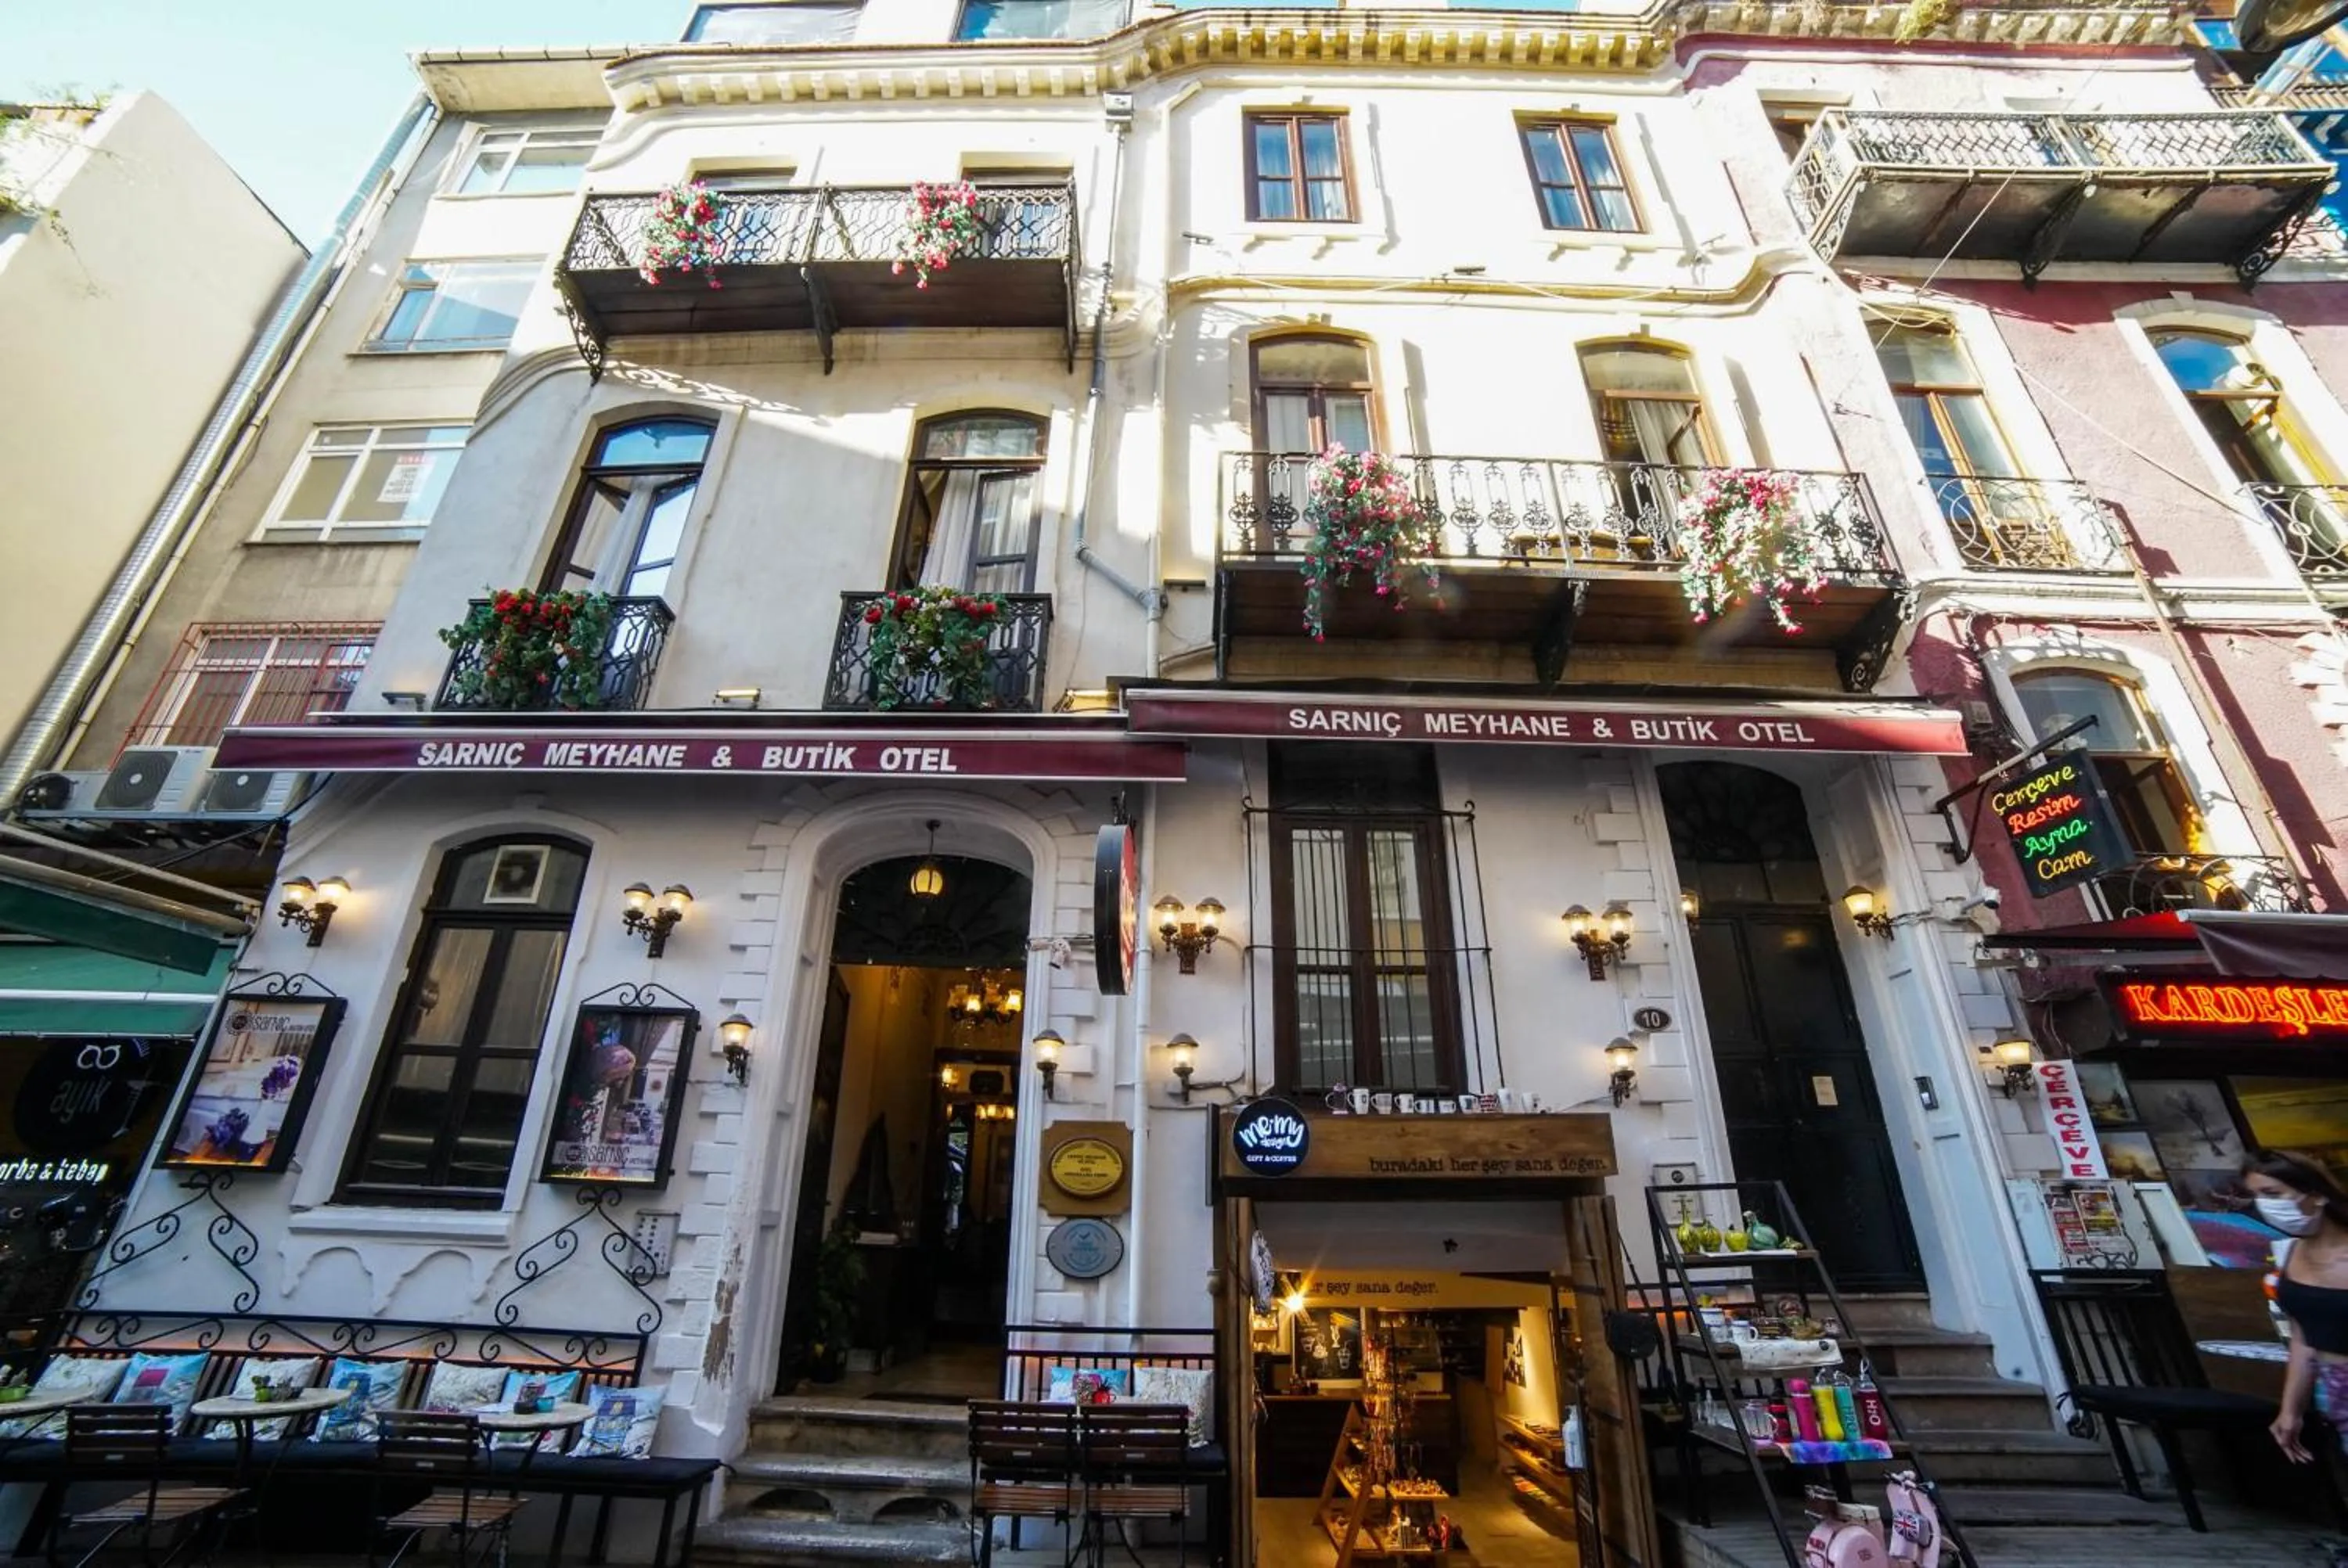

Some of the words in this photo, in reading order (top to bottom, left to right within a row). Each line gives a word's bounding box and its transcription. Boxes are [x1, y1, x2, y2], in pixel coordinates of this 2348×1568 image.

[1289, 708, 1402, 737] SARNIÇ
[1424, 712, 1571, 737] MEYHANE
[1593, 717, 1614, 738] &
[1630, 716, 1720, 741] BUTİK
[1738, 721, 1815, 743] OTEL
[543, 743, 687, 768] MEYHANE
[711, 745, 733, 768] &
[762, 742, 856, 771] BUTİK
[879, 746, 958, 772] OTEL
[1992, 765, 2076, 816] Çerçeve
[2008, 794, 2080, 835] Resim
[2025, 819, 2087, 858] Ayna
[2038, 851, 2093, 879] Cam
[1642, 1012, 1660, 1027] 10
[2126, 985, 2348, 1035] KARDEŞLE
[1450, 1157, 1478, 1171] her
[1514, 1160, 1553, 1171] sana
[1356, 1281, 1391, 1293] sana
